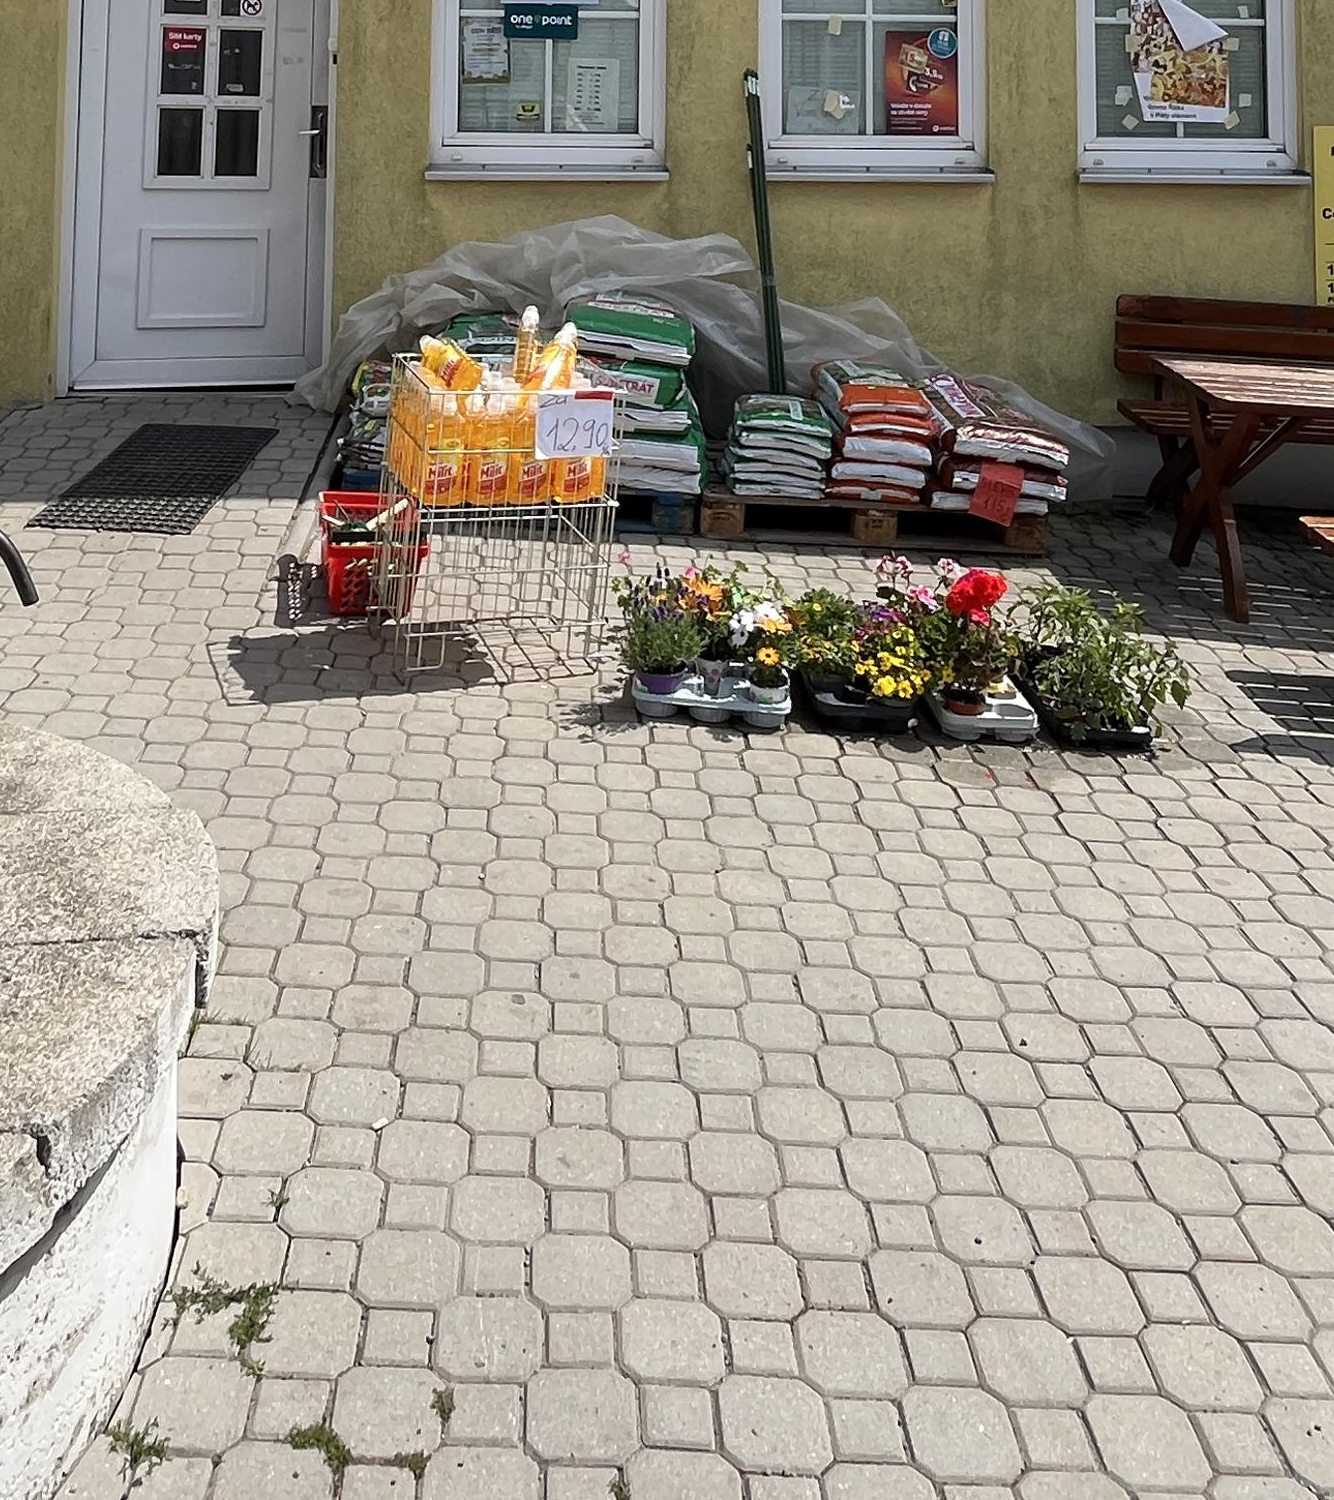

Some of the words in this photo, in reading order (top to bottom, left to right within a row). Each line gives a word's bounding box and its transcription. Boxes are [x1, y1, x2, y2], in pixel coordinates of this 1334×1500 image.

[510, 15, 533, 24] one
[183, 32, 203, 42] karty
[546, 417, 609, 452] 12,90
